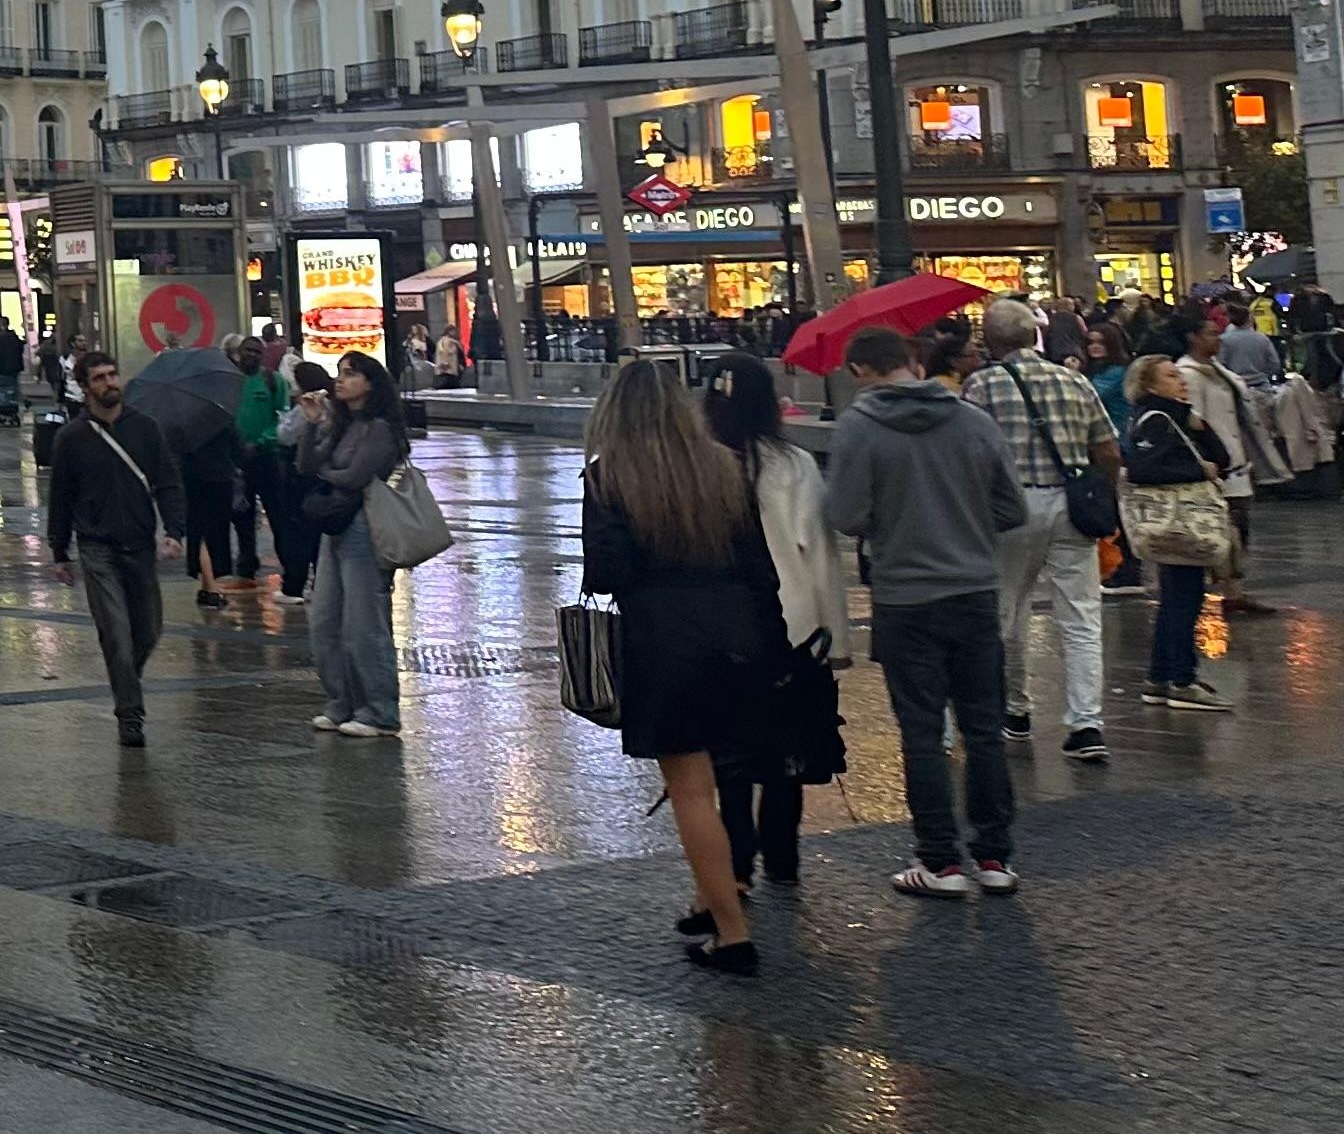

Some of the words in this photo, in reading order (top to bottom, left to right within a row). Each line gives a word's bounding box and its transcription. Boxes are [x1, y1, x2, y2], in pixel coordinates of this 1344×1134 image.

[696, 206, 755, 230] DIEGO
[910, 196, 1006, 220] DIEGO
[302, 250, 334, 260] GRAND
[303, 254, 376, 272] WHISKEY
[305, 266, 375, 289] BBQ
